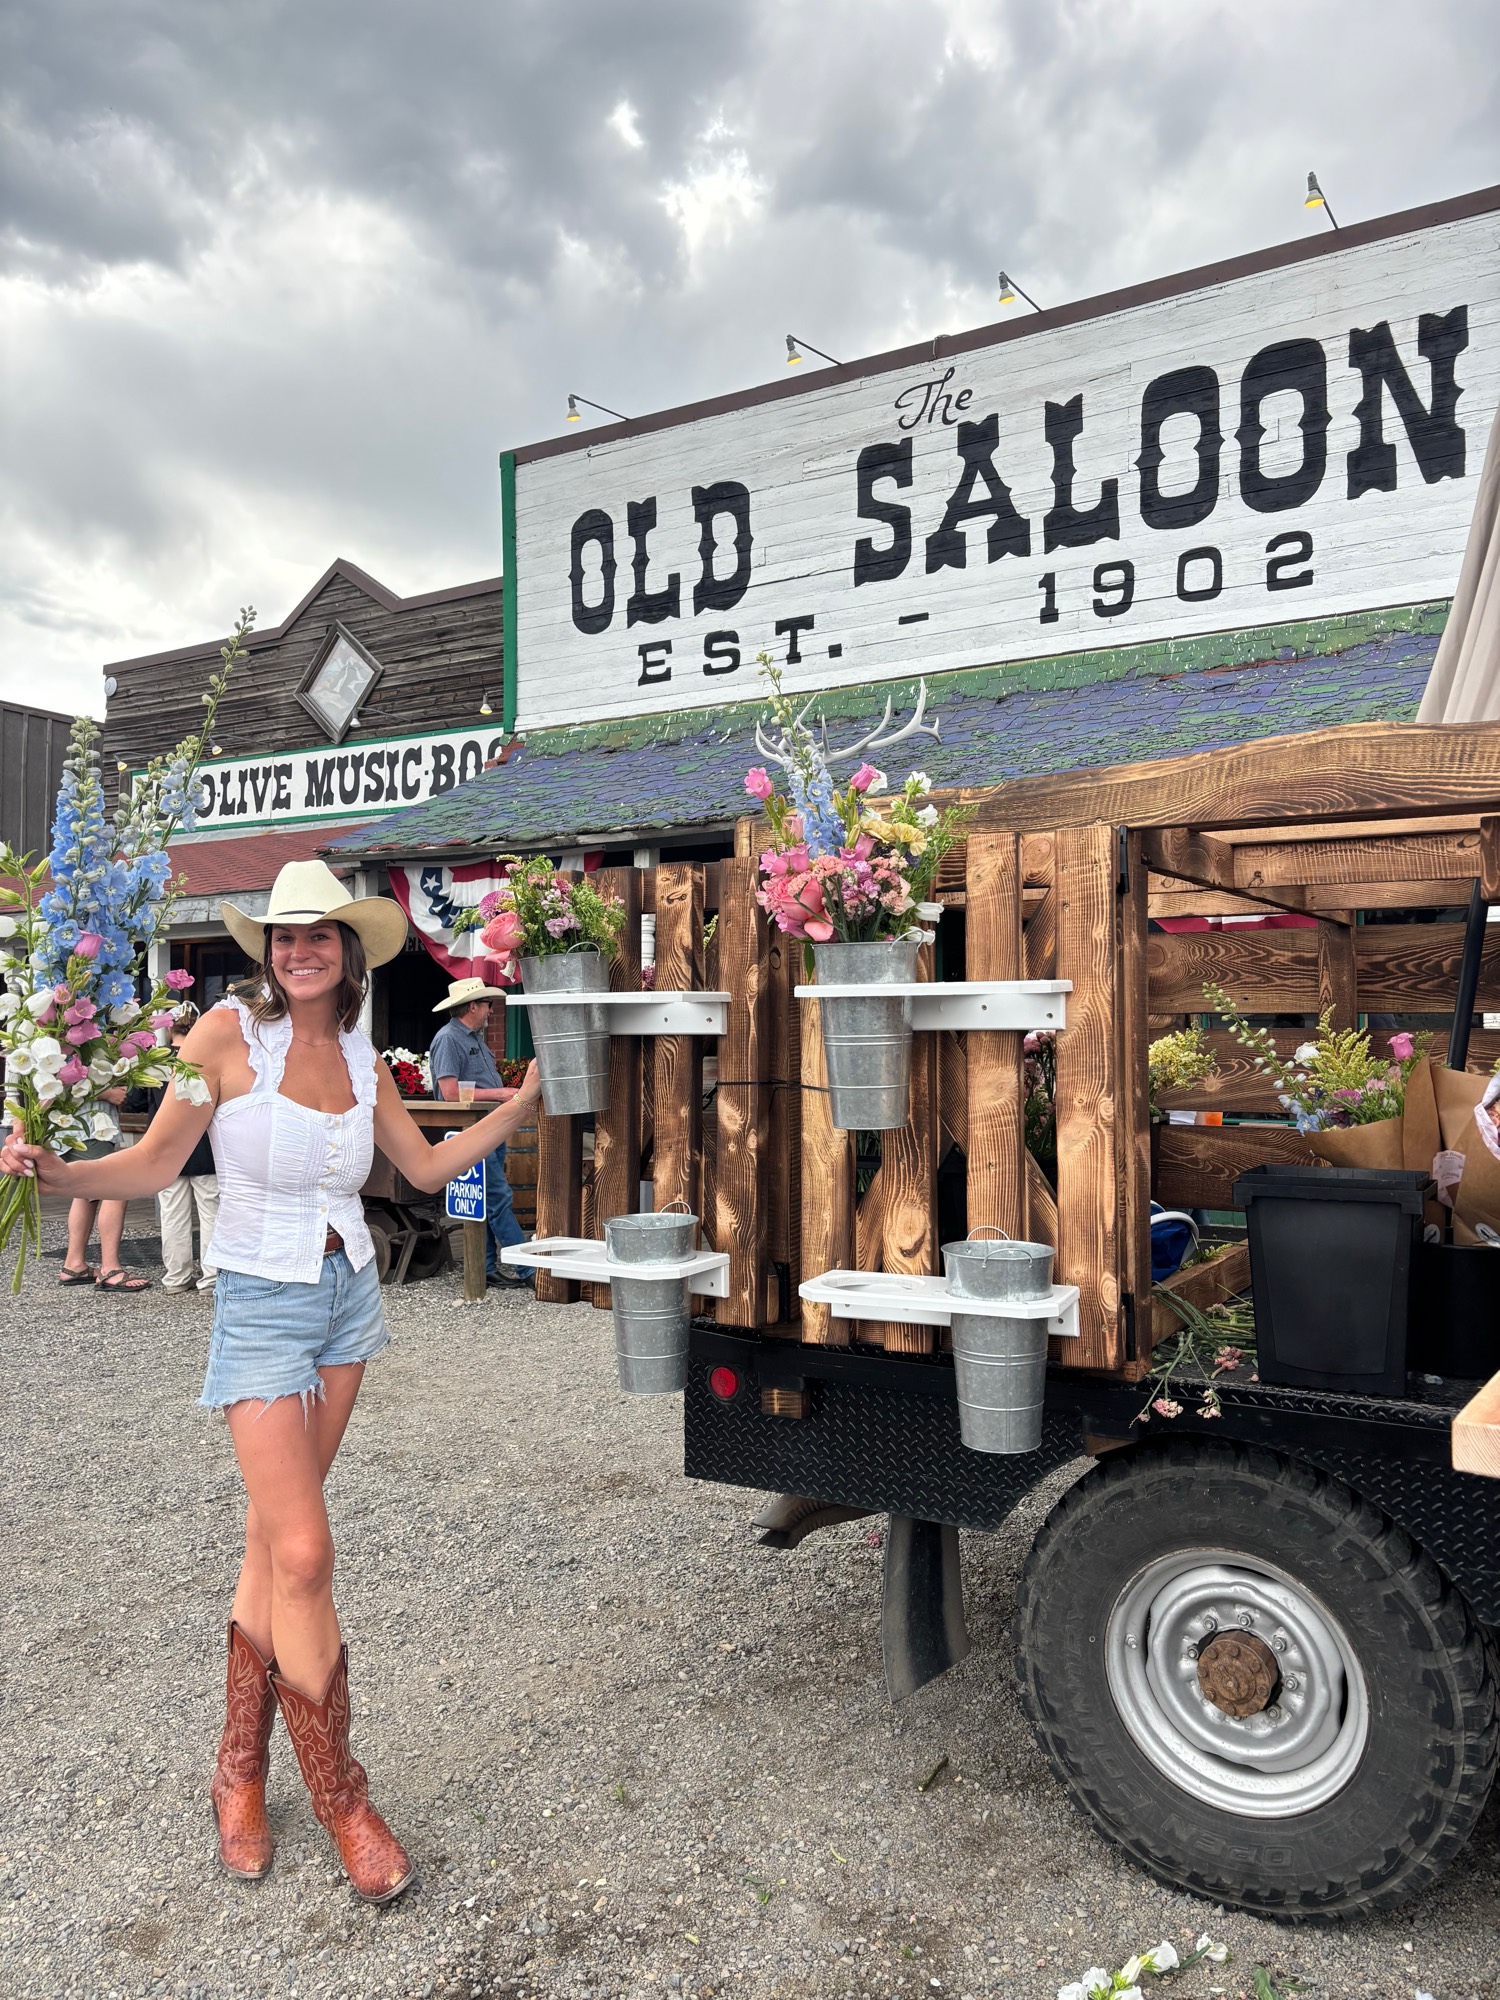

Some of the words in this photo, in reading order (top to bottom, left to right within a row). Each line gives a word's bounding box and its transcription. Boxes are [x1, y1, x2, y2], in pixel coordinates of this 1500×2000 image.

[894, 366, 973, 430] The
[568, 480, 754, 635] OLD
[854, 304, 1469, 587] SALOON
[638, 614, 843, 687] EST.
[1039, 531, 1314, 625] 1902
[450, 1181, 483, 1200] PARKING
[454, 1197, 477, 1215] ONLY
[1161, 1811, 1295, 1869] OPEN
